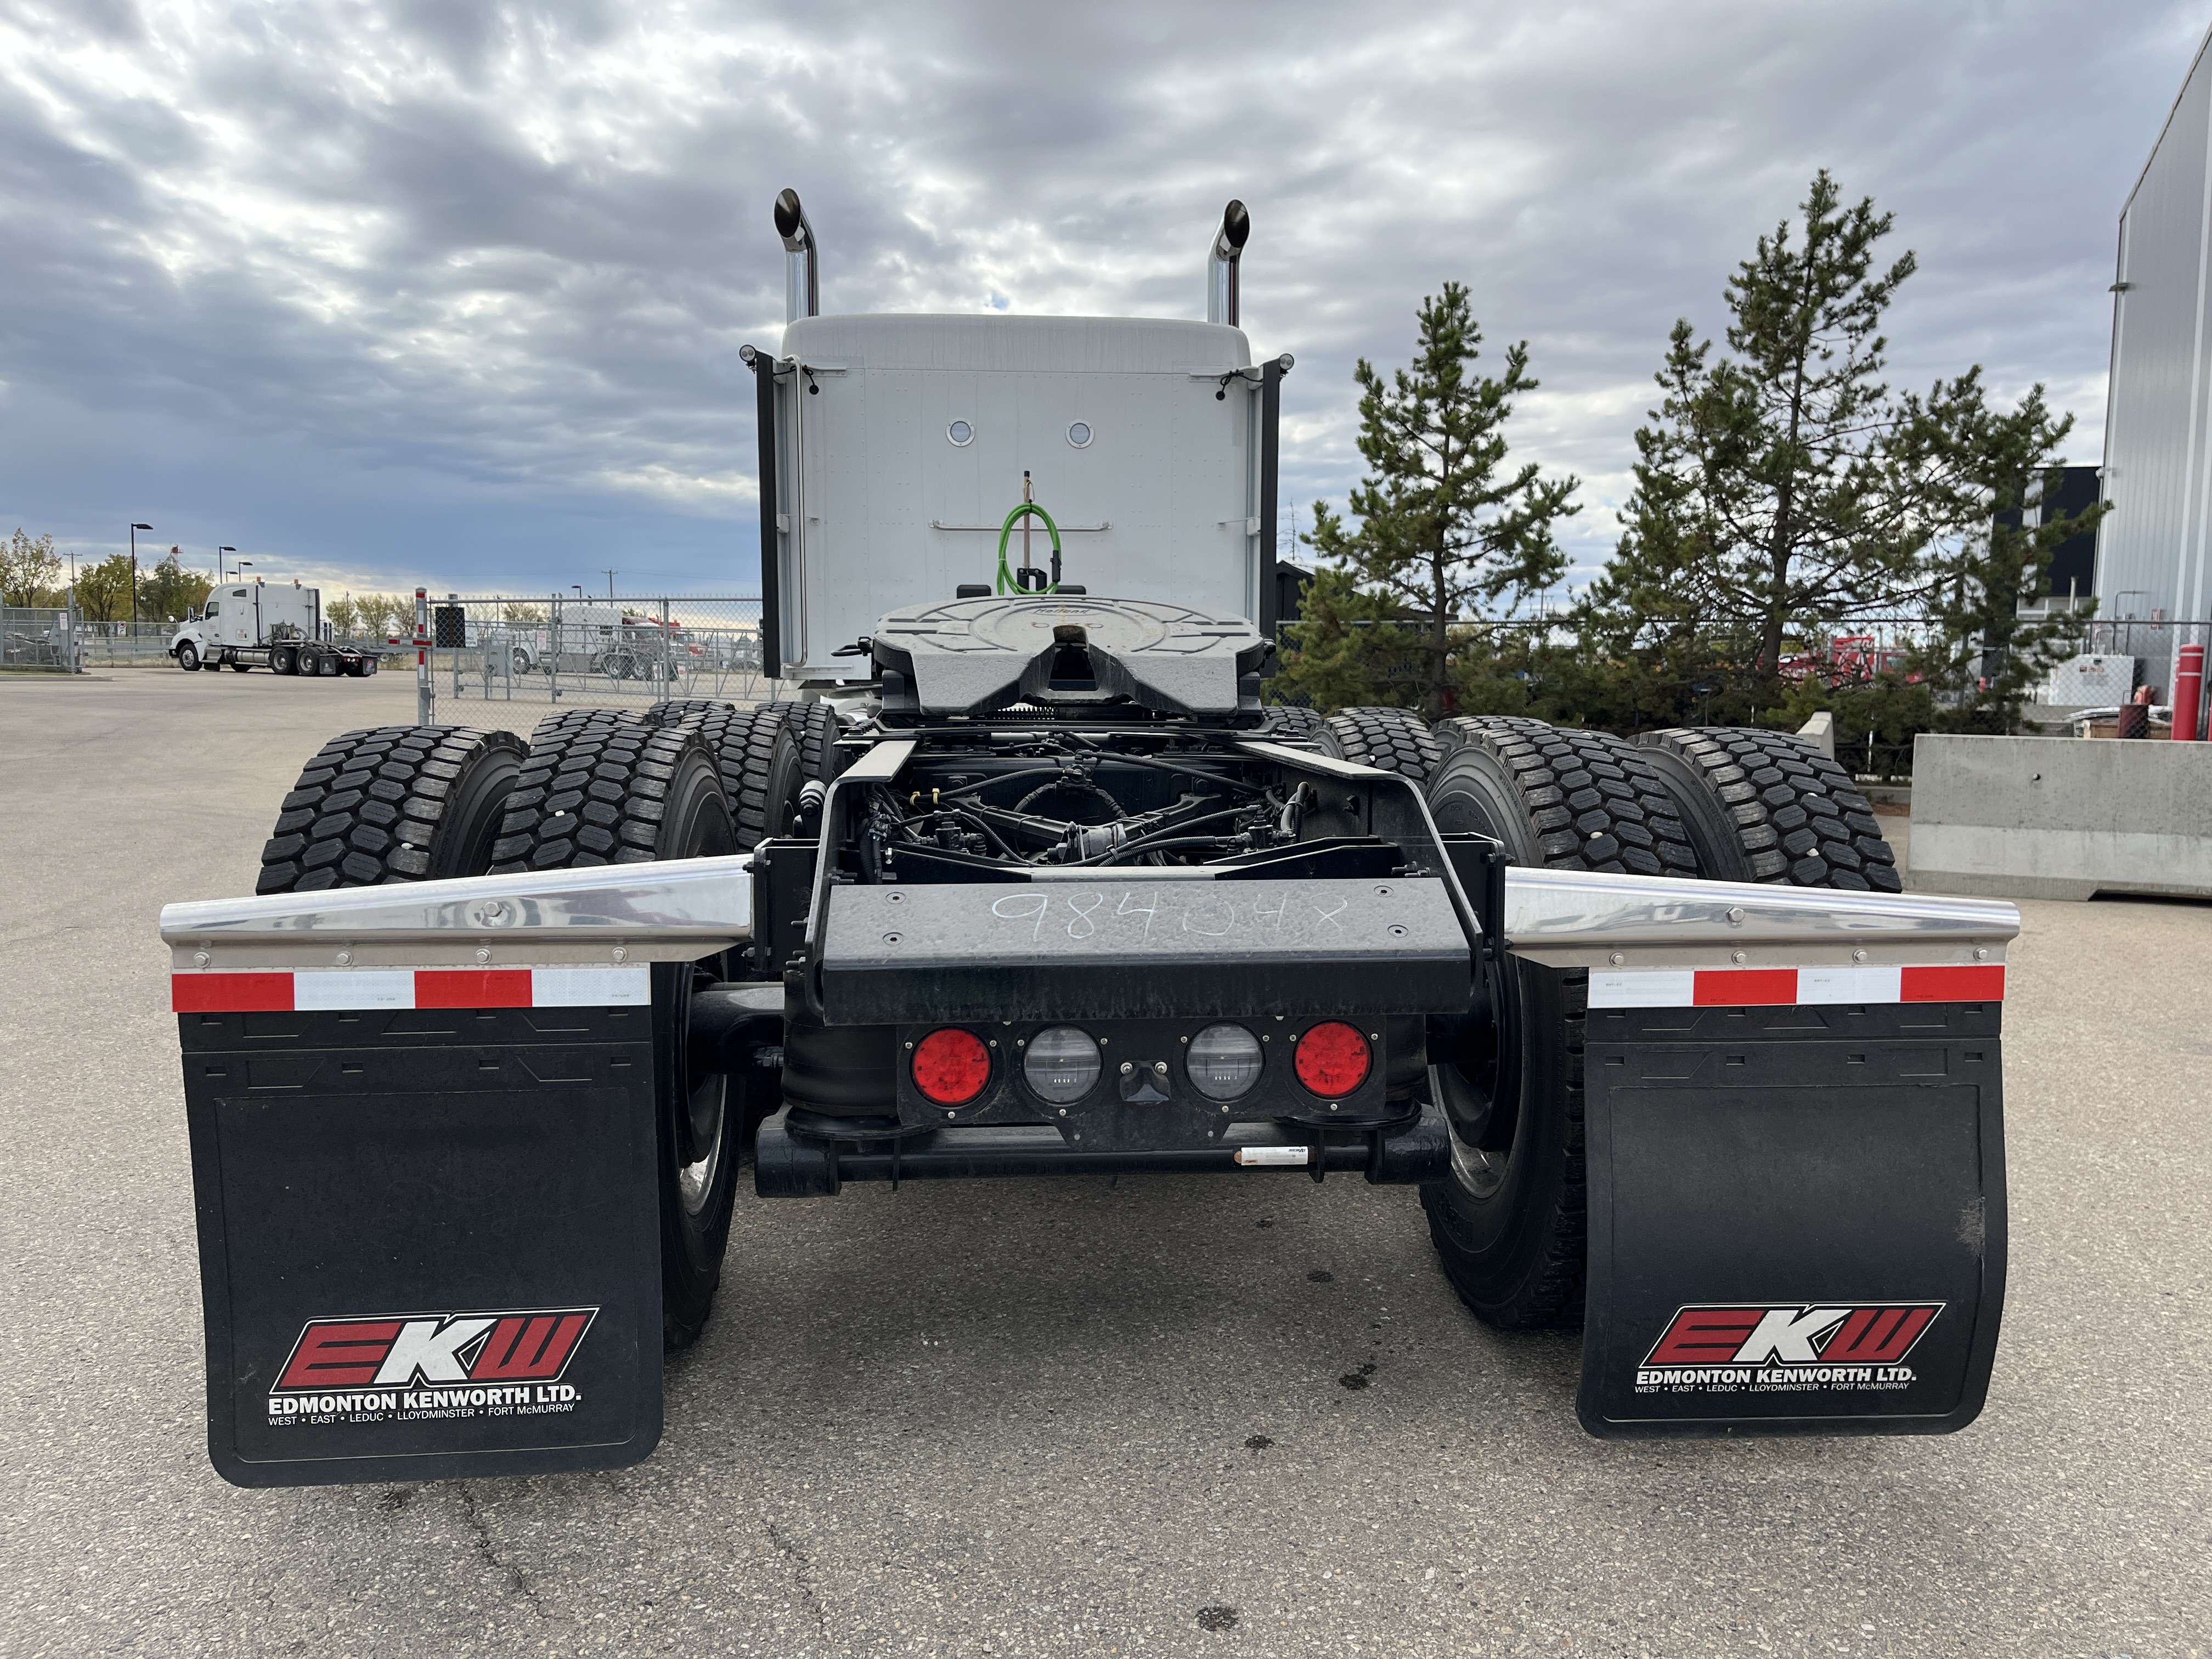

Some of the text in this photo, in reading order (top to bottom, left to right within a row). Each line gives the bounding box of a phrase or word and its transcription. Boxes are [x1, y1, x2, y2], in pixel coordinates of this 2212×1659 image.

[1649, 1308, 1935, 1363] EKW
[279, 1314, 588, 1387] EKW
[1636, 1368, 1917, 1385] EDMONTON KENWORTH LTD.
[1749, 1383, 1819, 1392] LLOYDMINSTER
[268, 1385, 582, 1415] EDMONTON KENWORTH LTD.
[268, 1403, 575, 1426] WEST EAST LEDUC LLOYDMINSTER FORT McMURRAY
